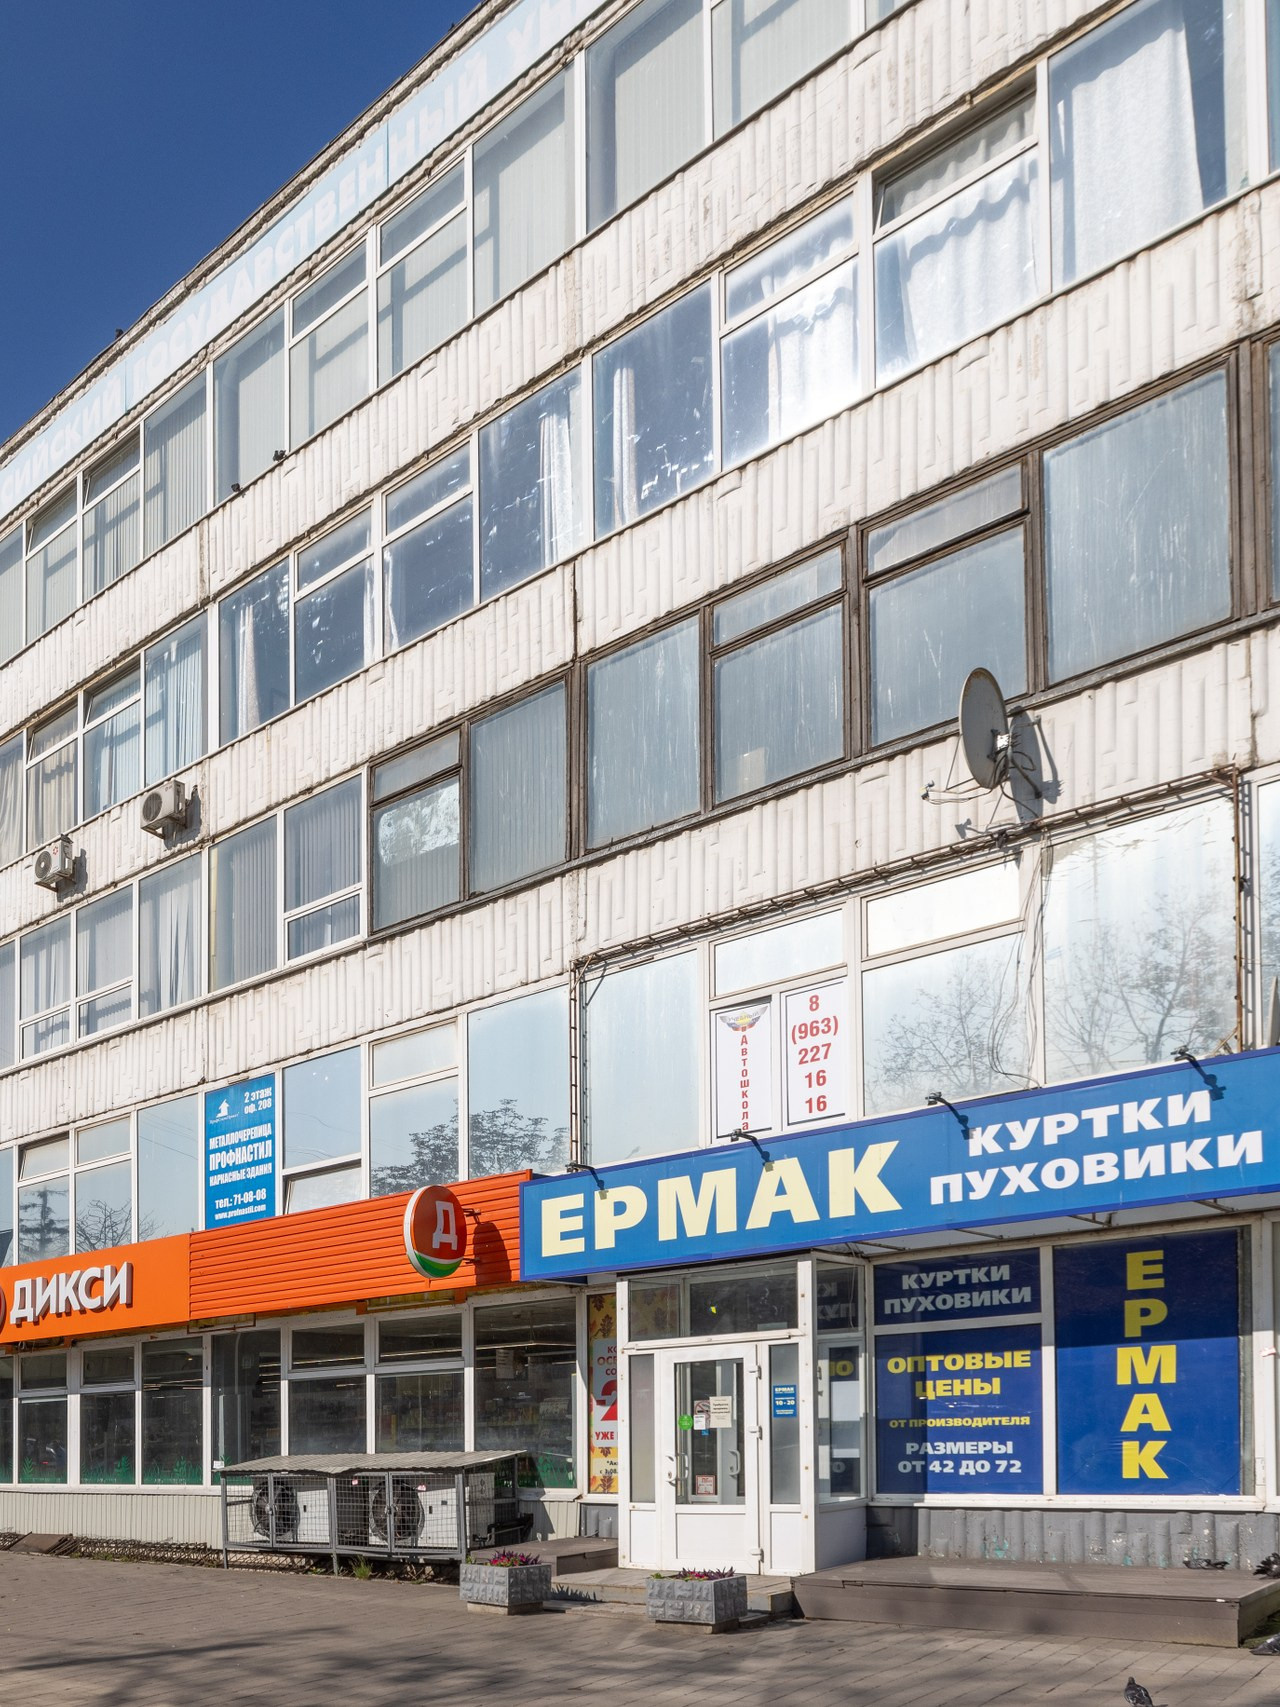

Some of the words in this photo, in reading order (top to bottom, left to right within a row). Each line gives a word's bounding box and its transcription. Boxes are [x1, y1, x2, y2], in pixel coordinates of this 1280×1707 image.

[132, 50, 488, 400] ГОСУДАРСТВЕННЫЙ
[809, 995, 819, 1011] 8
[791, 1015, 839, 1045] (963)
[798, 1043, 832, 1066] 227
[805, 1069, 827, 1089] 16
[244, 1091, 251, 1102] 2
[251, 1087, 272, 1101] этаж
[244, 1102, 257, 1115] оф.
[258, 1097, 272, 1111] 208
[805, 1095, 827, 1114] 16
[209, 1122, 272, 1150] МЕТАЛЛОЧЕРЕПИЦА
[968, 1091, 1212, 1157] КУРТКИ
[209, 1139, 272, 1171] ПРОФНАСТИЛ
[209, 1168, 246, 1187] КАРКАСНЫЕ
[246, 1162, 272, 1180] ЗДАНИЯ
[930, 1130, 1264, 1206] ПУХОВИКИ
[233, 1188, 267, 1204] 71-08-08
[541, 1140, 903, 1258] ЕРМАК
[432, 1201, 459, 1250] Д
[902, 1264, 1011, 1290] КУРТКИ
[10, 1262, 132, 1326] ДИКСИ
[884, 1284, 1032, 1316] ПУХОВИКИ
[887, 1349, 1032, 1375] ОПТОВЫЕ
[1115, 1250, 1179, 1480] ЕРМАК
[914, 1376, 1002, 1401] ЦЕНЫ
[889, 1416, 906, 1428] ОТ
[909, 1415, 1031, 1429] ПРОИЗВОДИТЕЛЯ
[595, 1431, 614, 1440] УЖЕ
[905, 1440, 1014, 1457] РАЗМЕРЫ
[898, 1459, 925, 1475] ОТ
[929, 1459, 954, 1475] 42
[958, 1459, 992, 1477] ДО
[995, 1459, 1022, 1475] 72
